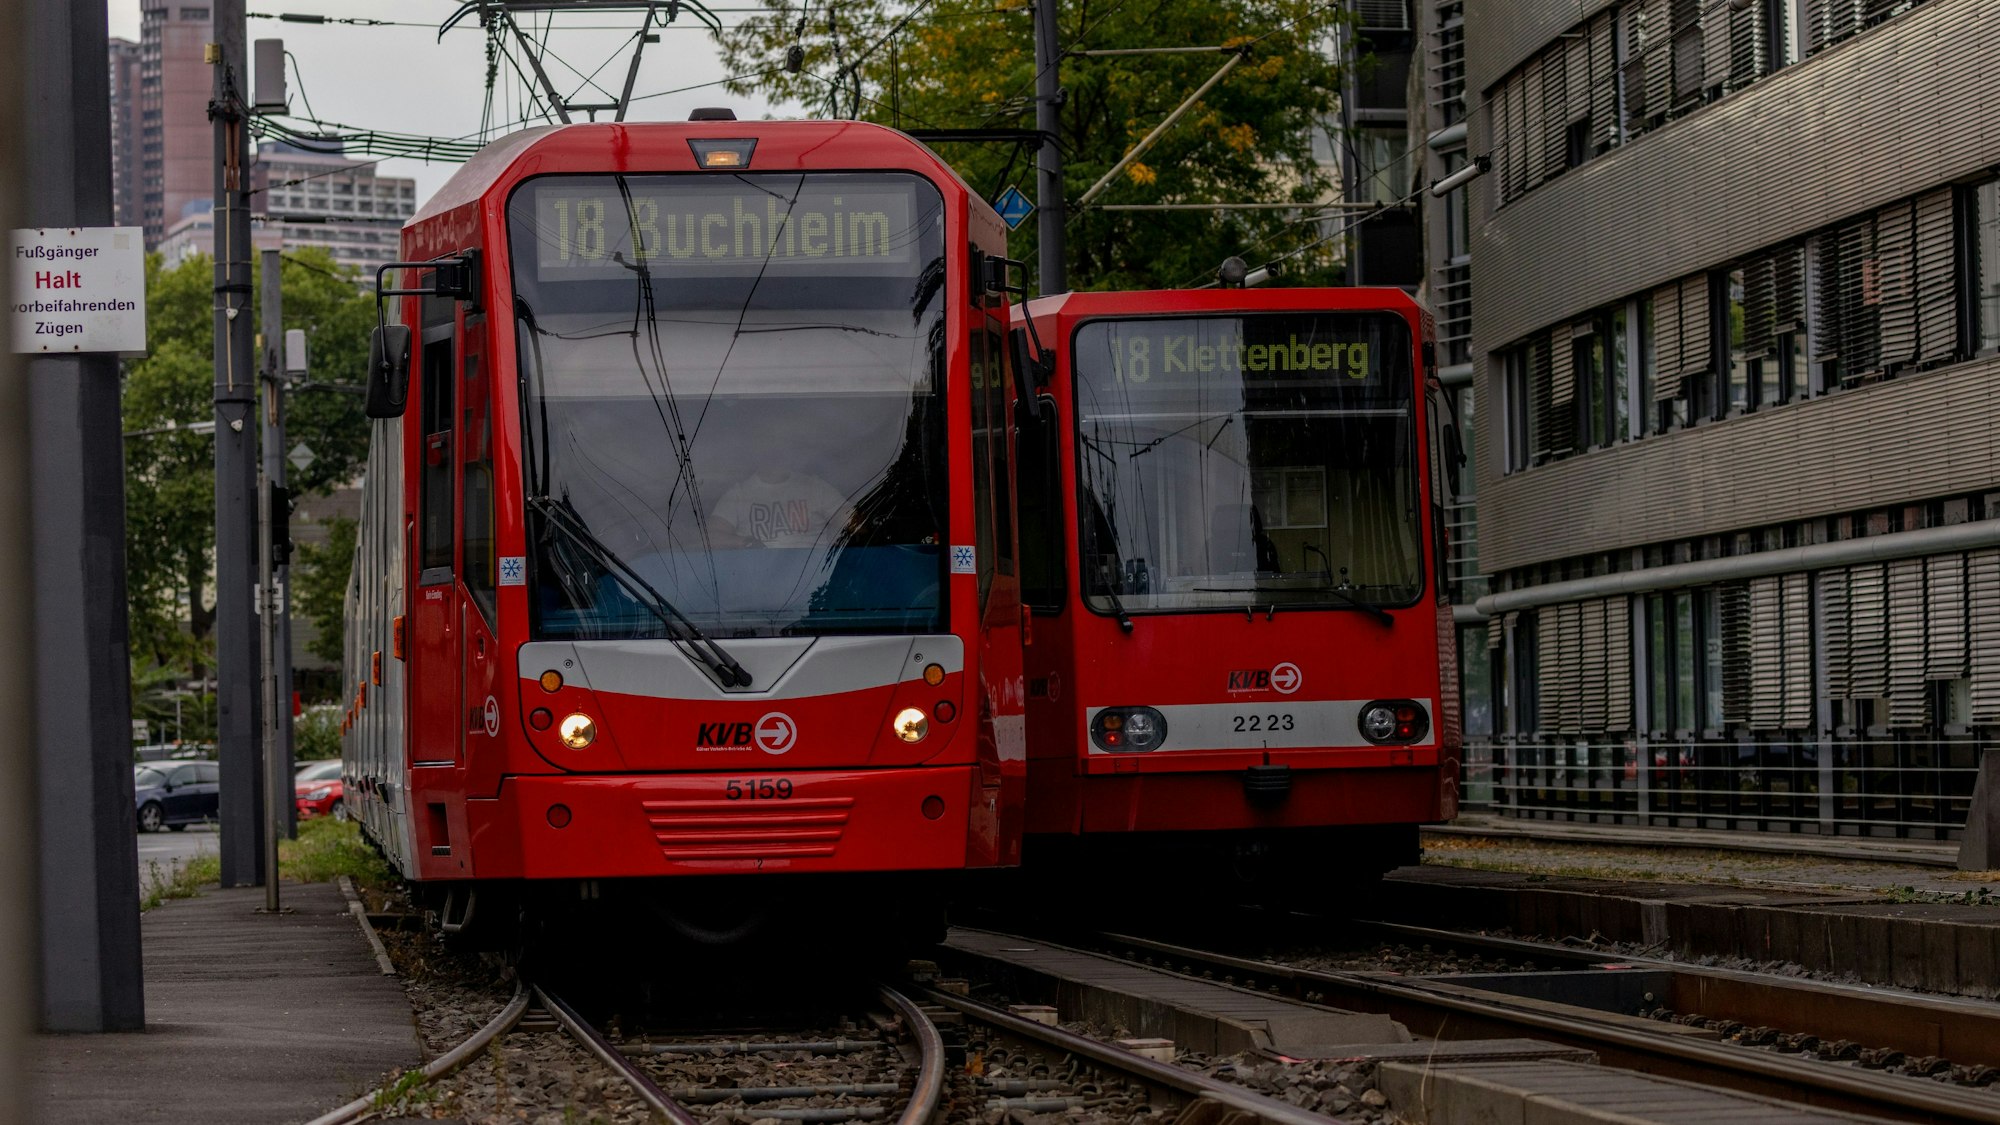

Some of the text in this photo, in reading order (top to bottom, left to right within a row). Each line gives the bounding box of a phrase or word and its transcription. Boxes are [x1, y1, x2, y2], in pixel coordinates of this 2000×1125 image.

[554, 194, 890, 260] 18 Buchheim
[16, 245, 99, 260] Fußgänger
[35, 271, 82, 289] Halt
[10, 299, 135, 313] vorbeifahrenden
[35, 322, 83, 336] Zügen
[1111, 333, 1369, 383] 18 Klettenberg
[1228, 671, 1269, 688] KVB
[697, 722, 753, 746] KVB
[726, 778, 793, 800] 5159
